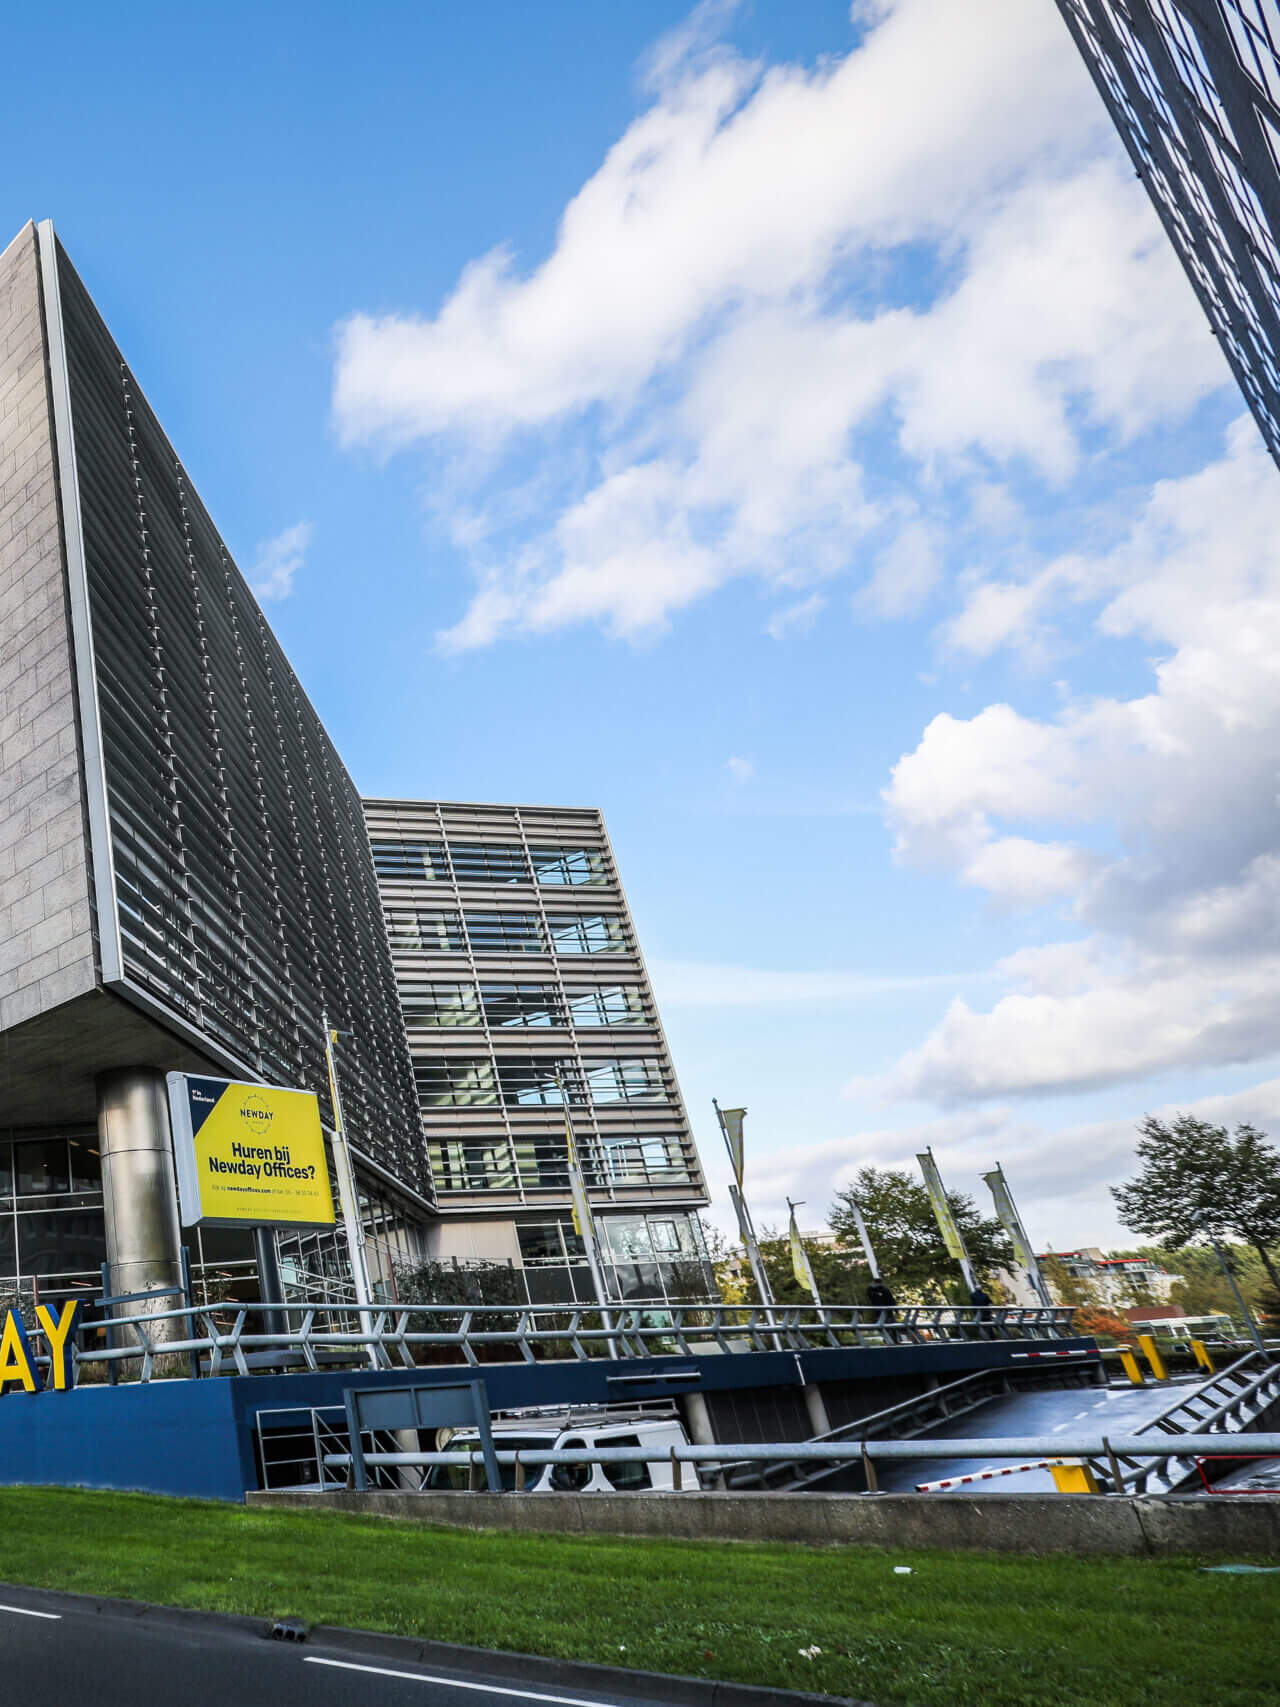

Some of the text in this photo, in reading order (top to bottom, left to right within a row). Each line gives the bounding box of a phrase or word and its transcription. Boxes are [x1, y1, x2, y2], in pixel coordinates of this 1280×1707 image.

[240, 1108, 274, 1120] NEWDAY
[232, 1142, 290, 1165] Huren bij
[209, 1156, 315, 1180] Newday Offices?
